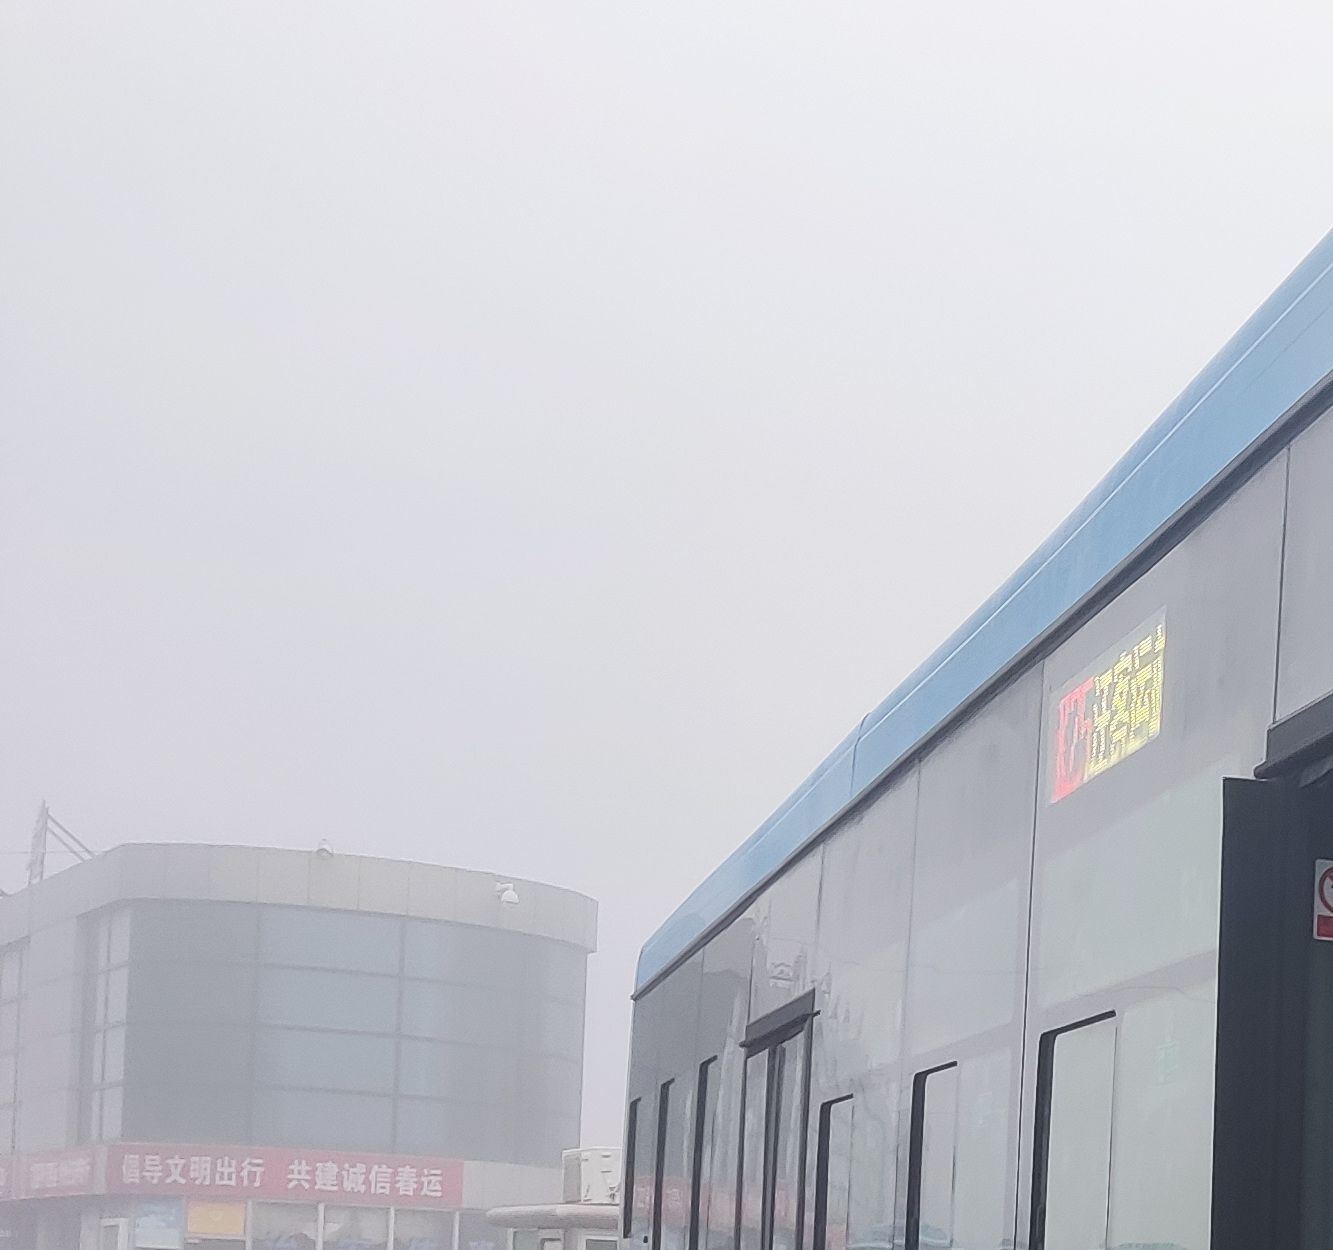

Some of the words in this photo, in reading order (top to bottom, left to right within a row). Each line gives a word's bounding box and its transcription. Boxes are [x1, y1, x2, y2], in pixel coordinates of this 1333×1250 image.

[122, 1153, 265, 1188] 倡导文明出行
[287, 1159, 444, 1198] 共建诚信春运
